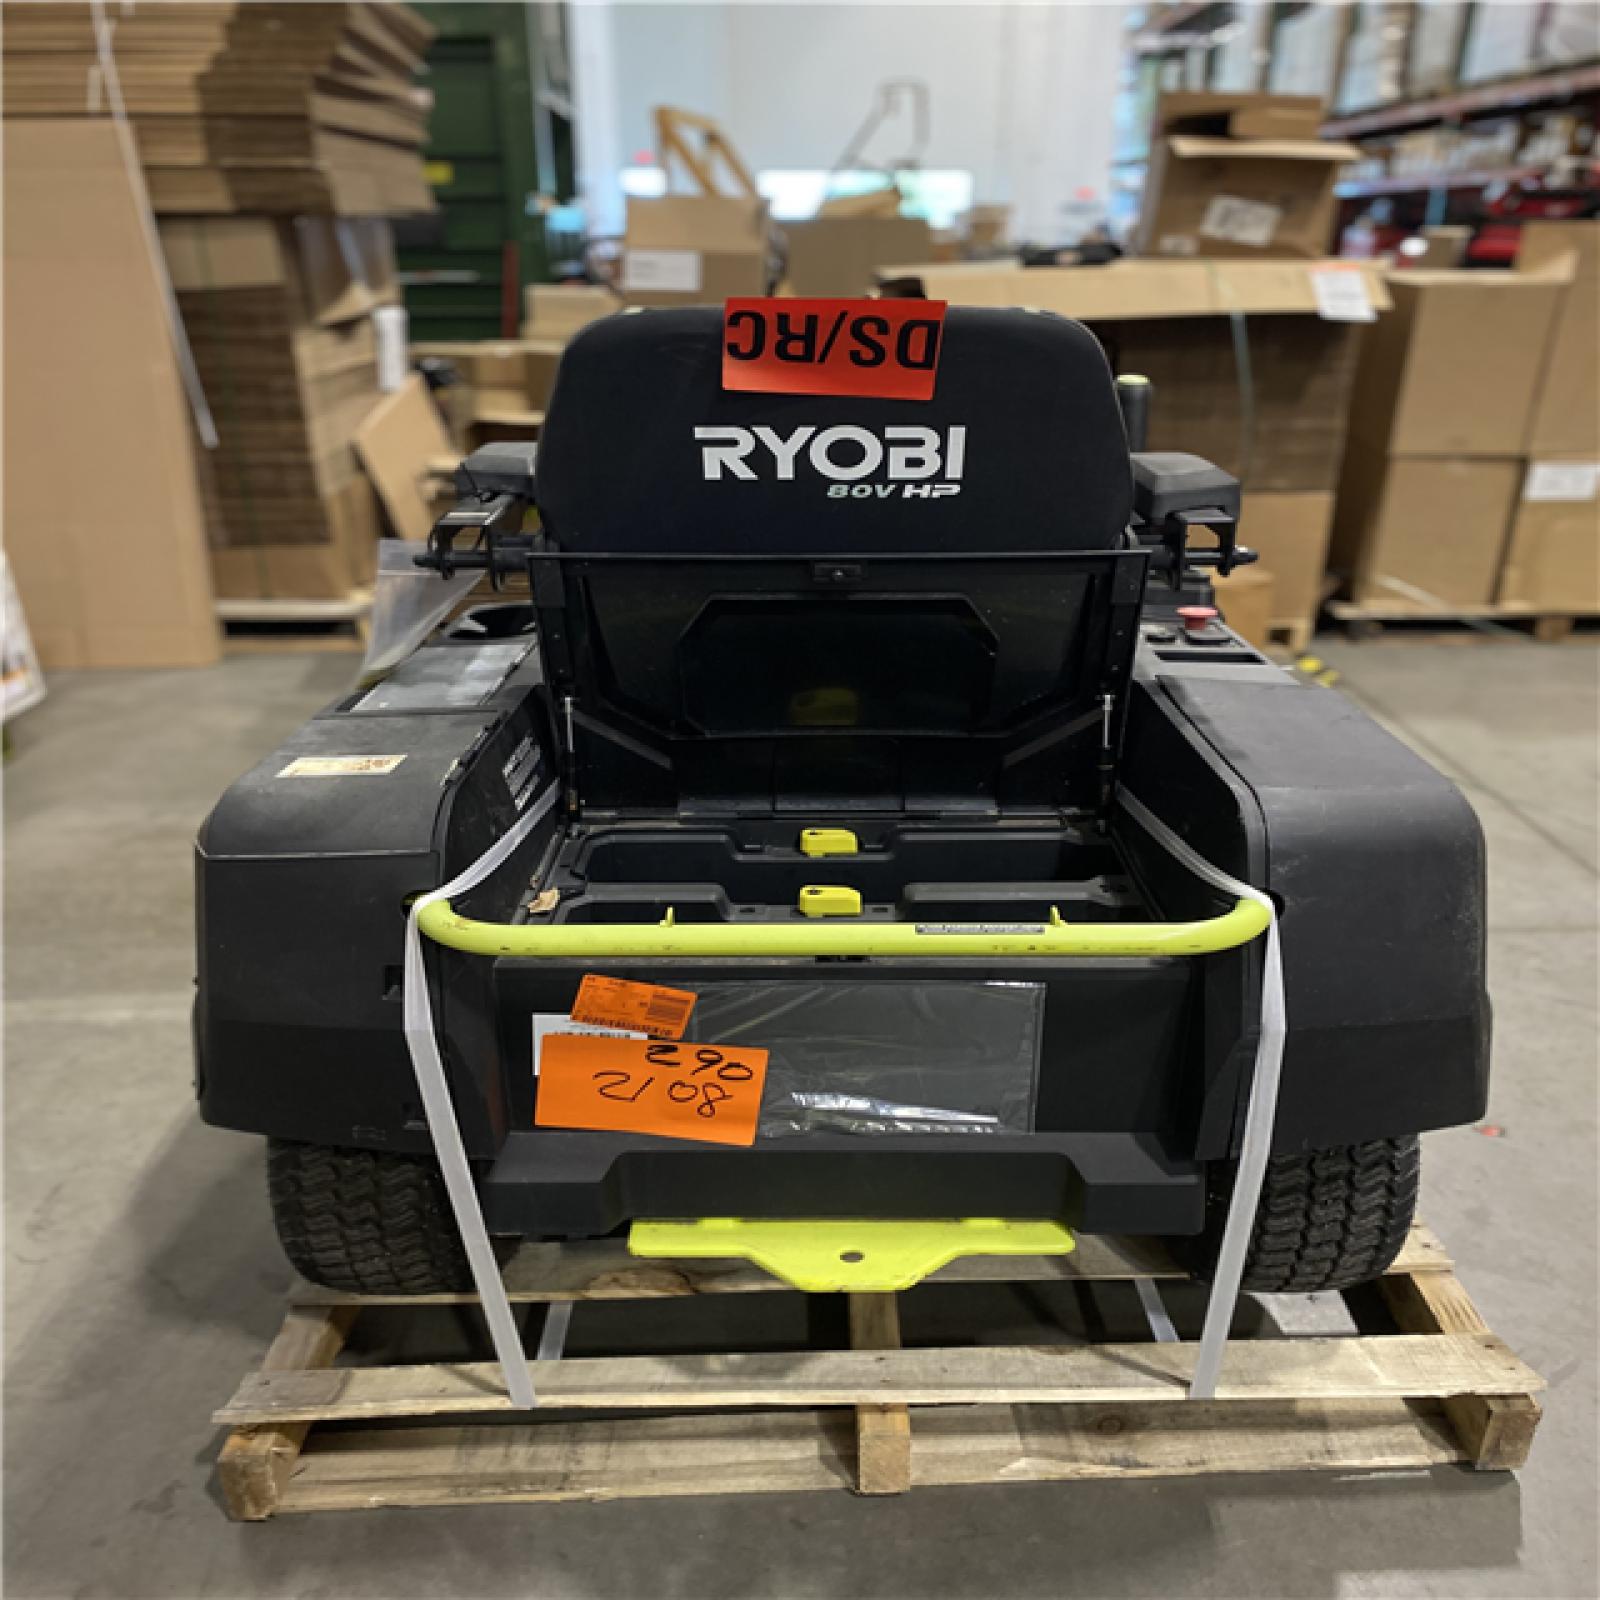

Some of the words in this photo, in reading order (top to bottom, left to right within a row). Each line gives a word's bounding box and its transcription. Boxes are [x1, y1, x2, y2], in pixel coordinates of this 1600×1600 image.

[726, 310, 941, 371] DS/RC
[694, 425, 966, 481] RYOBI
[826, 484, 896, 499] 80V
[902, 484, 961, 499] HP
